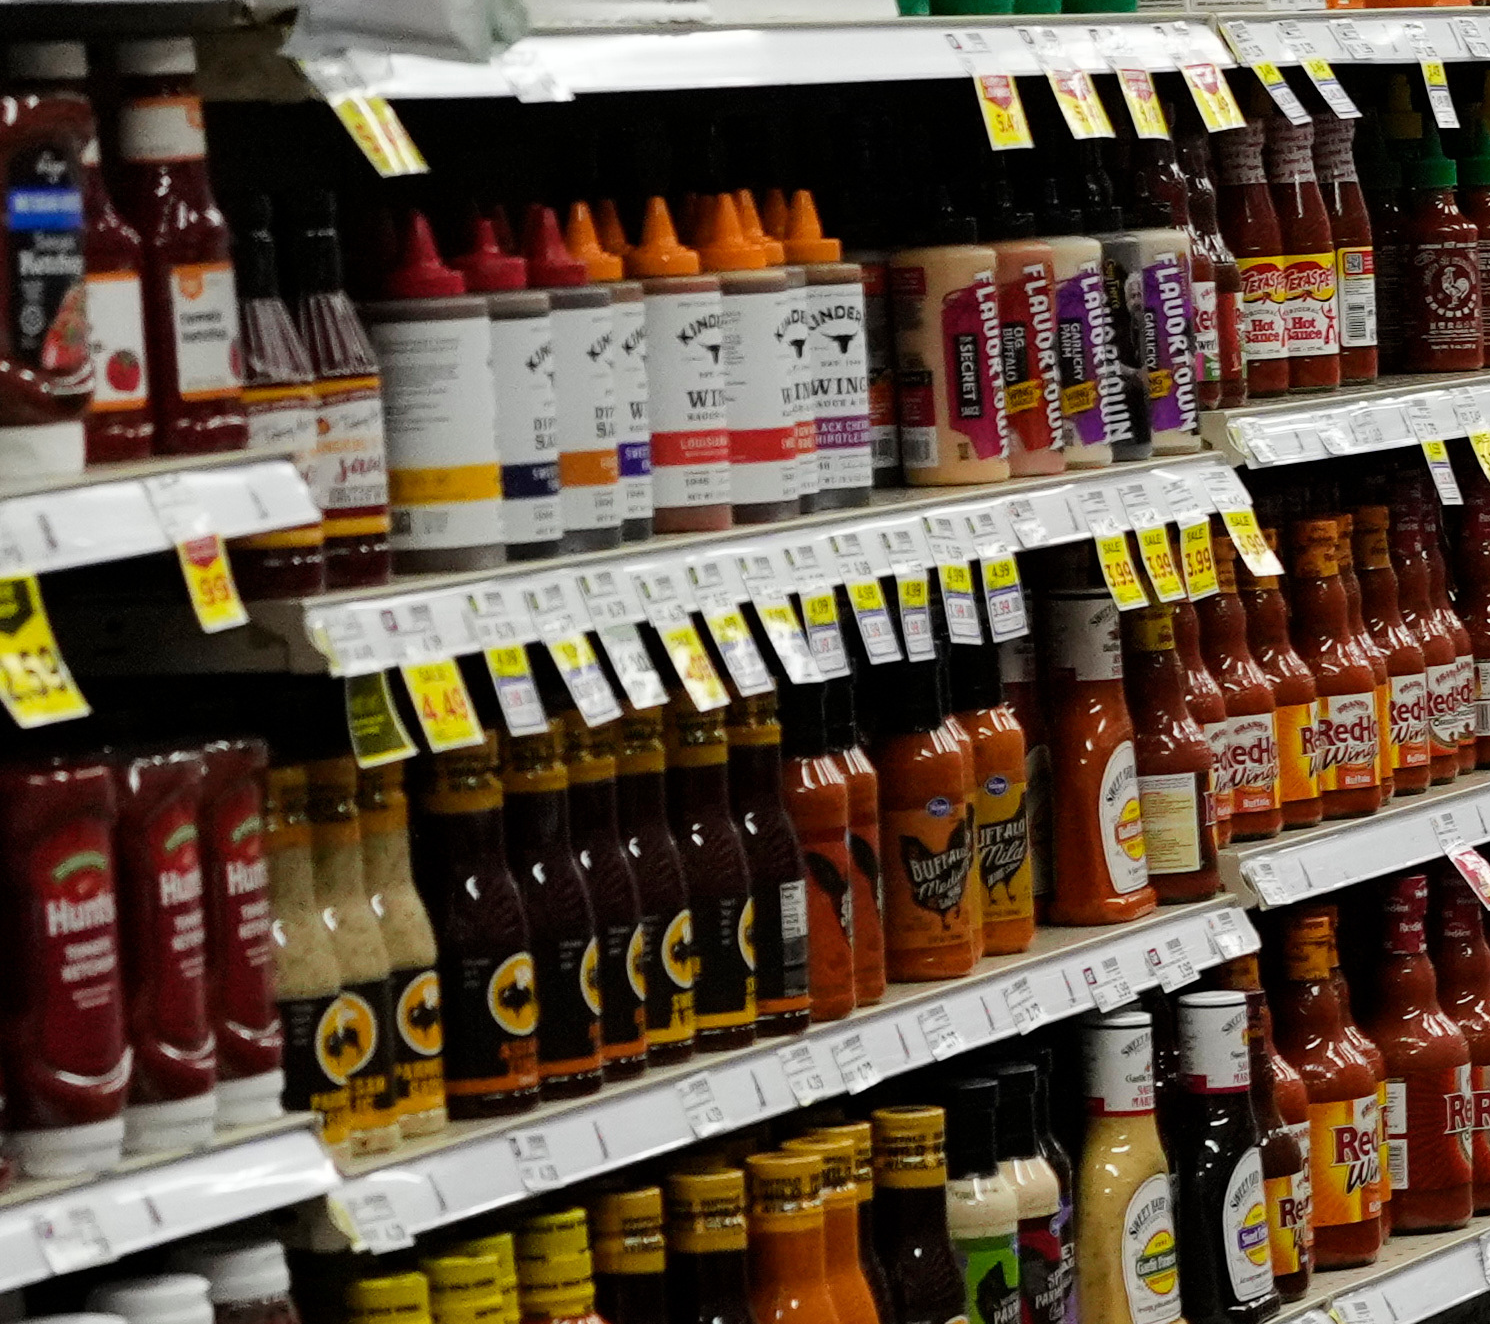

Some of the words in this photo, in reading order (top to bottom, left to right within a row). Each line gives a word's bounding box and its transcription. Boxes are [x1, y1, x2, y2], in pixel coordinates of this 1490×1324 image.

[1252, 318, 1275, 332] Hot
[1293, 316, 1316, 331] Hot
[1014, 325, 1025, 352] OG
[1060, 322, 1071, 360] PARM
[1144, 312, 1158, 371] GARLICKY
[1154, 252, 1197, 434] FLAVORTOWN
[1244, 331, 1281, 344] Sauce
[1002, 326, 1016, 382] BUFFALO
[1070, 321, 1084, 382] GARLICKY
[1230, 515, 1250, 527] SALE
[1102, 540, 1121, 555] SALE
[1144, 533, 1163, 547] SALE
[1186, 528, 1204, 543] SALE
[945, 565, 965, 582] 4.99
[989, 562, 1012, 579] 4.99
[1104, 561, 1136, 588] 3.99
[1146, 552, 1174, 580] 3.99
[1185, 546, 1211, 576] 3.99
[423, 689, 469, 723] 4.49
